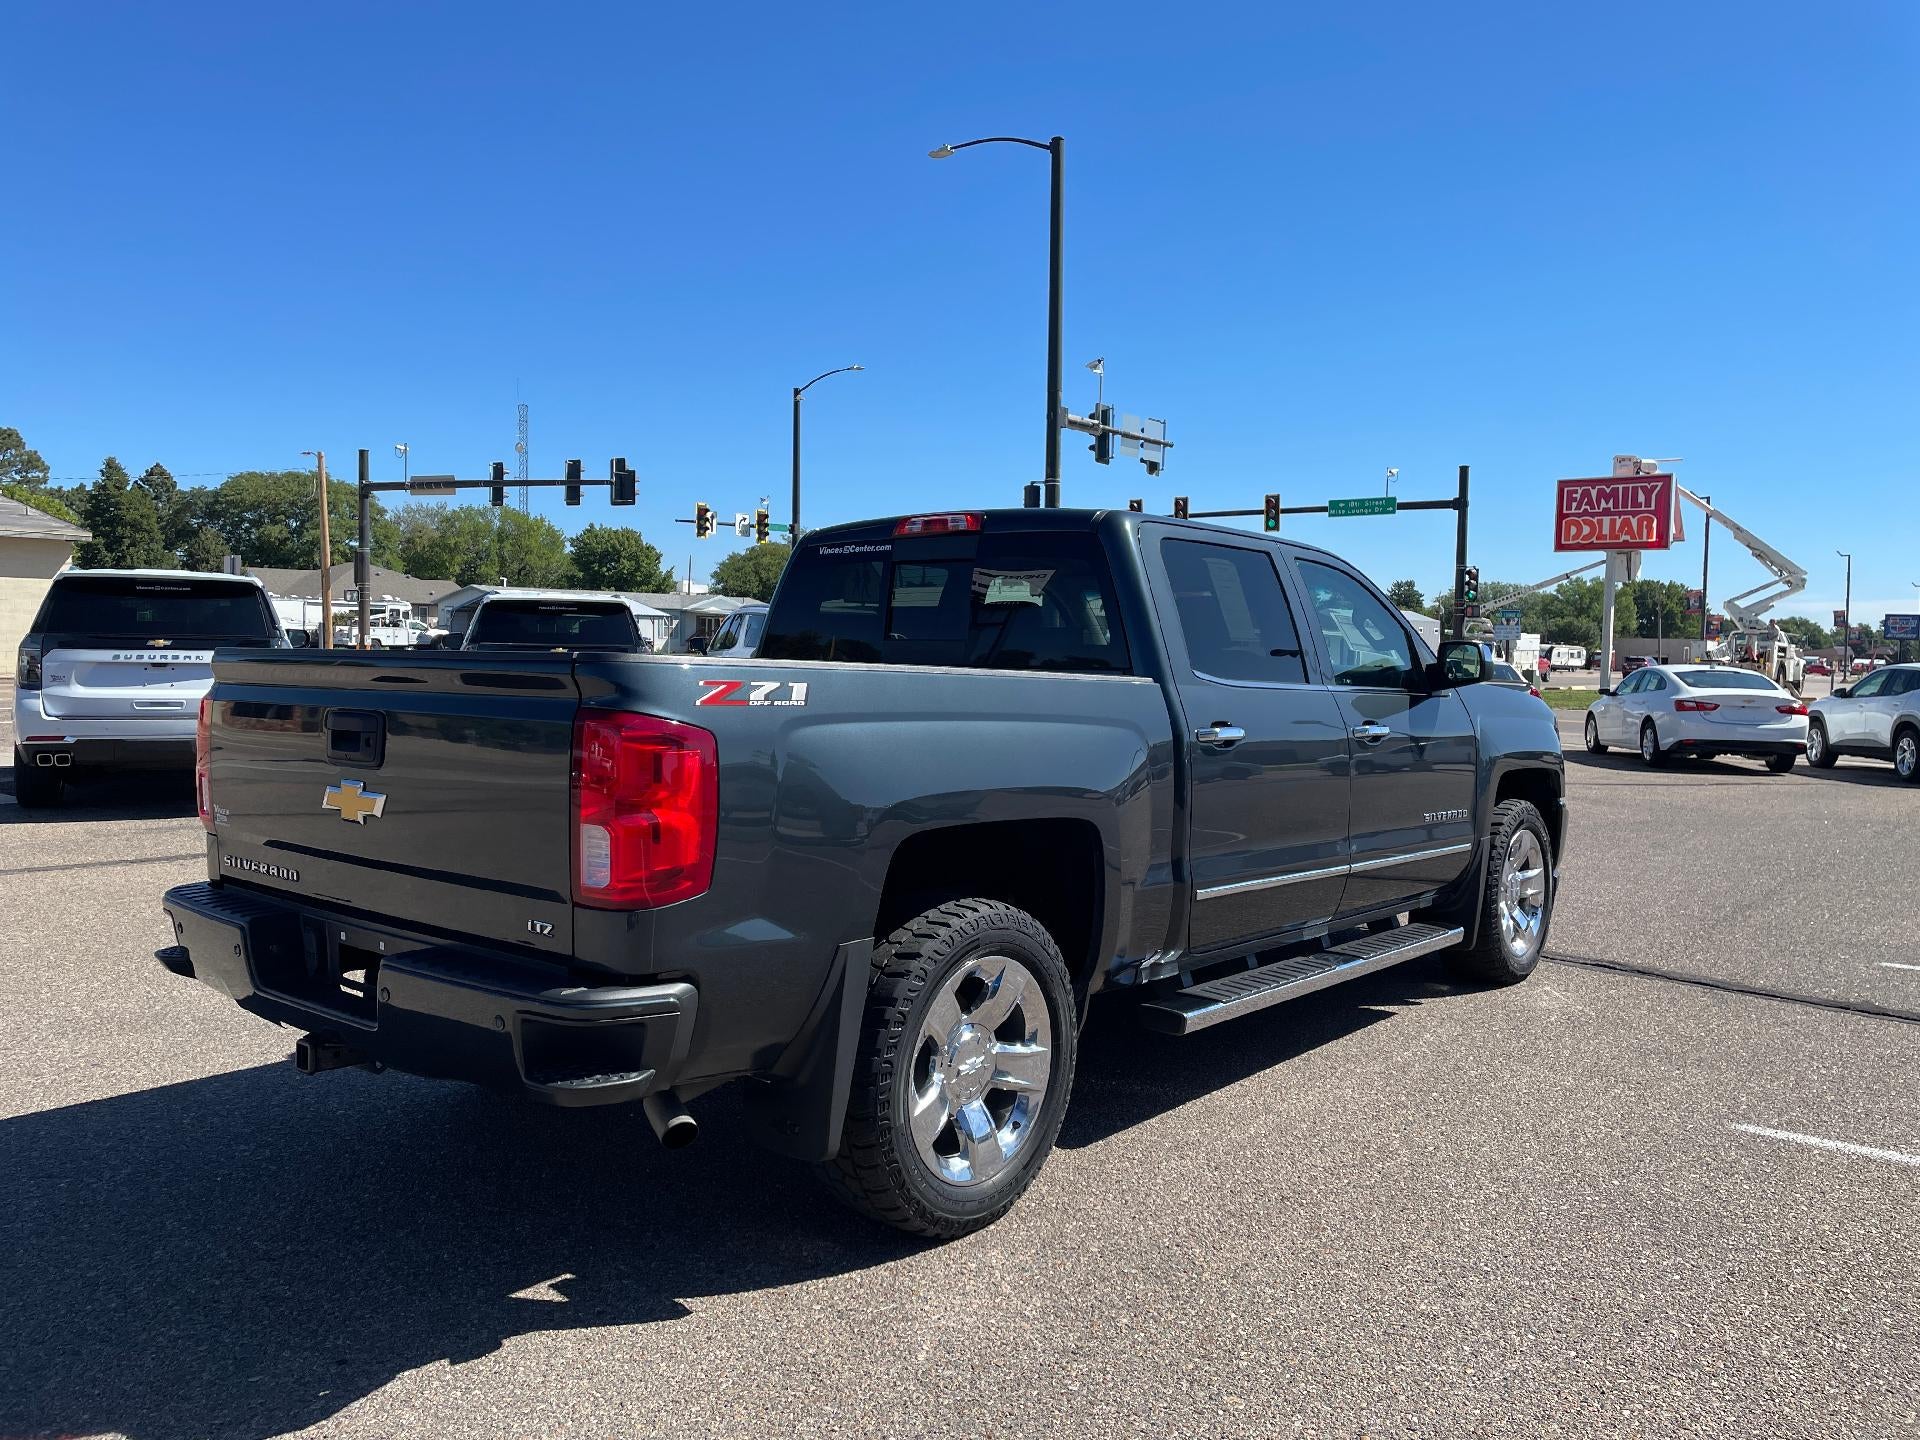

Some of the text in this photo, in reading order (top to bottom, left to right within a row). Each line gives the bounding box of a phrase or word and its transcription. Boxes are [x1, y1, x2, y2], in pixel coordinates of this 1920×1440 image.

[1364, 499, 1386, 507] Street
[1563, 482, 1663, 513] FAMILY
[1561, 514, 1657, 544] DOLLAR
[695, 680, 808, 706] Z71
[1423, 809, 1469, 823] SILVERADO
[224, 854, 299, 882] SILVERADO
[527, 919, 554, 937] LTZ
